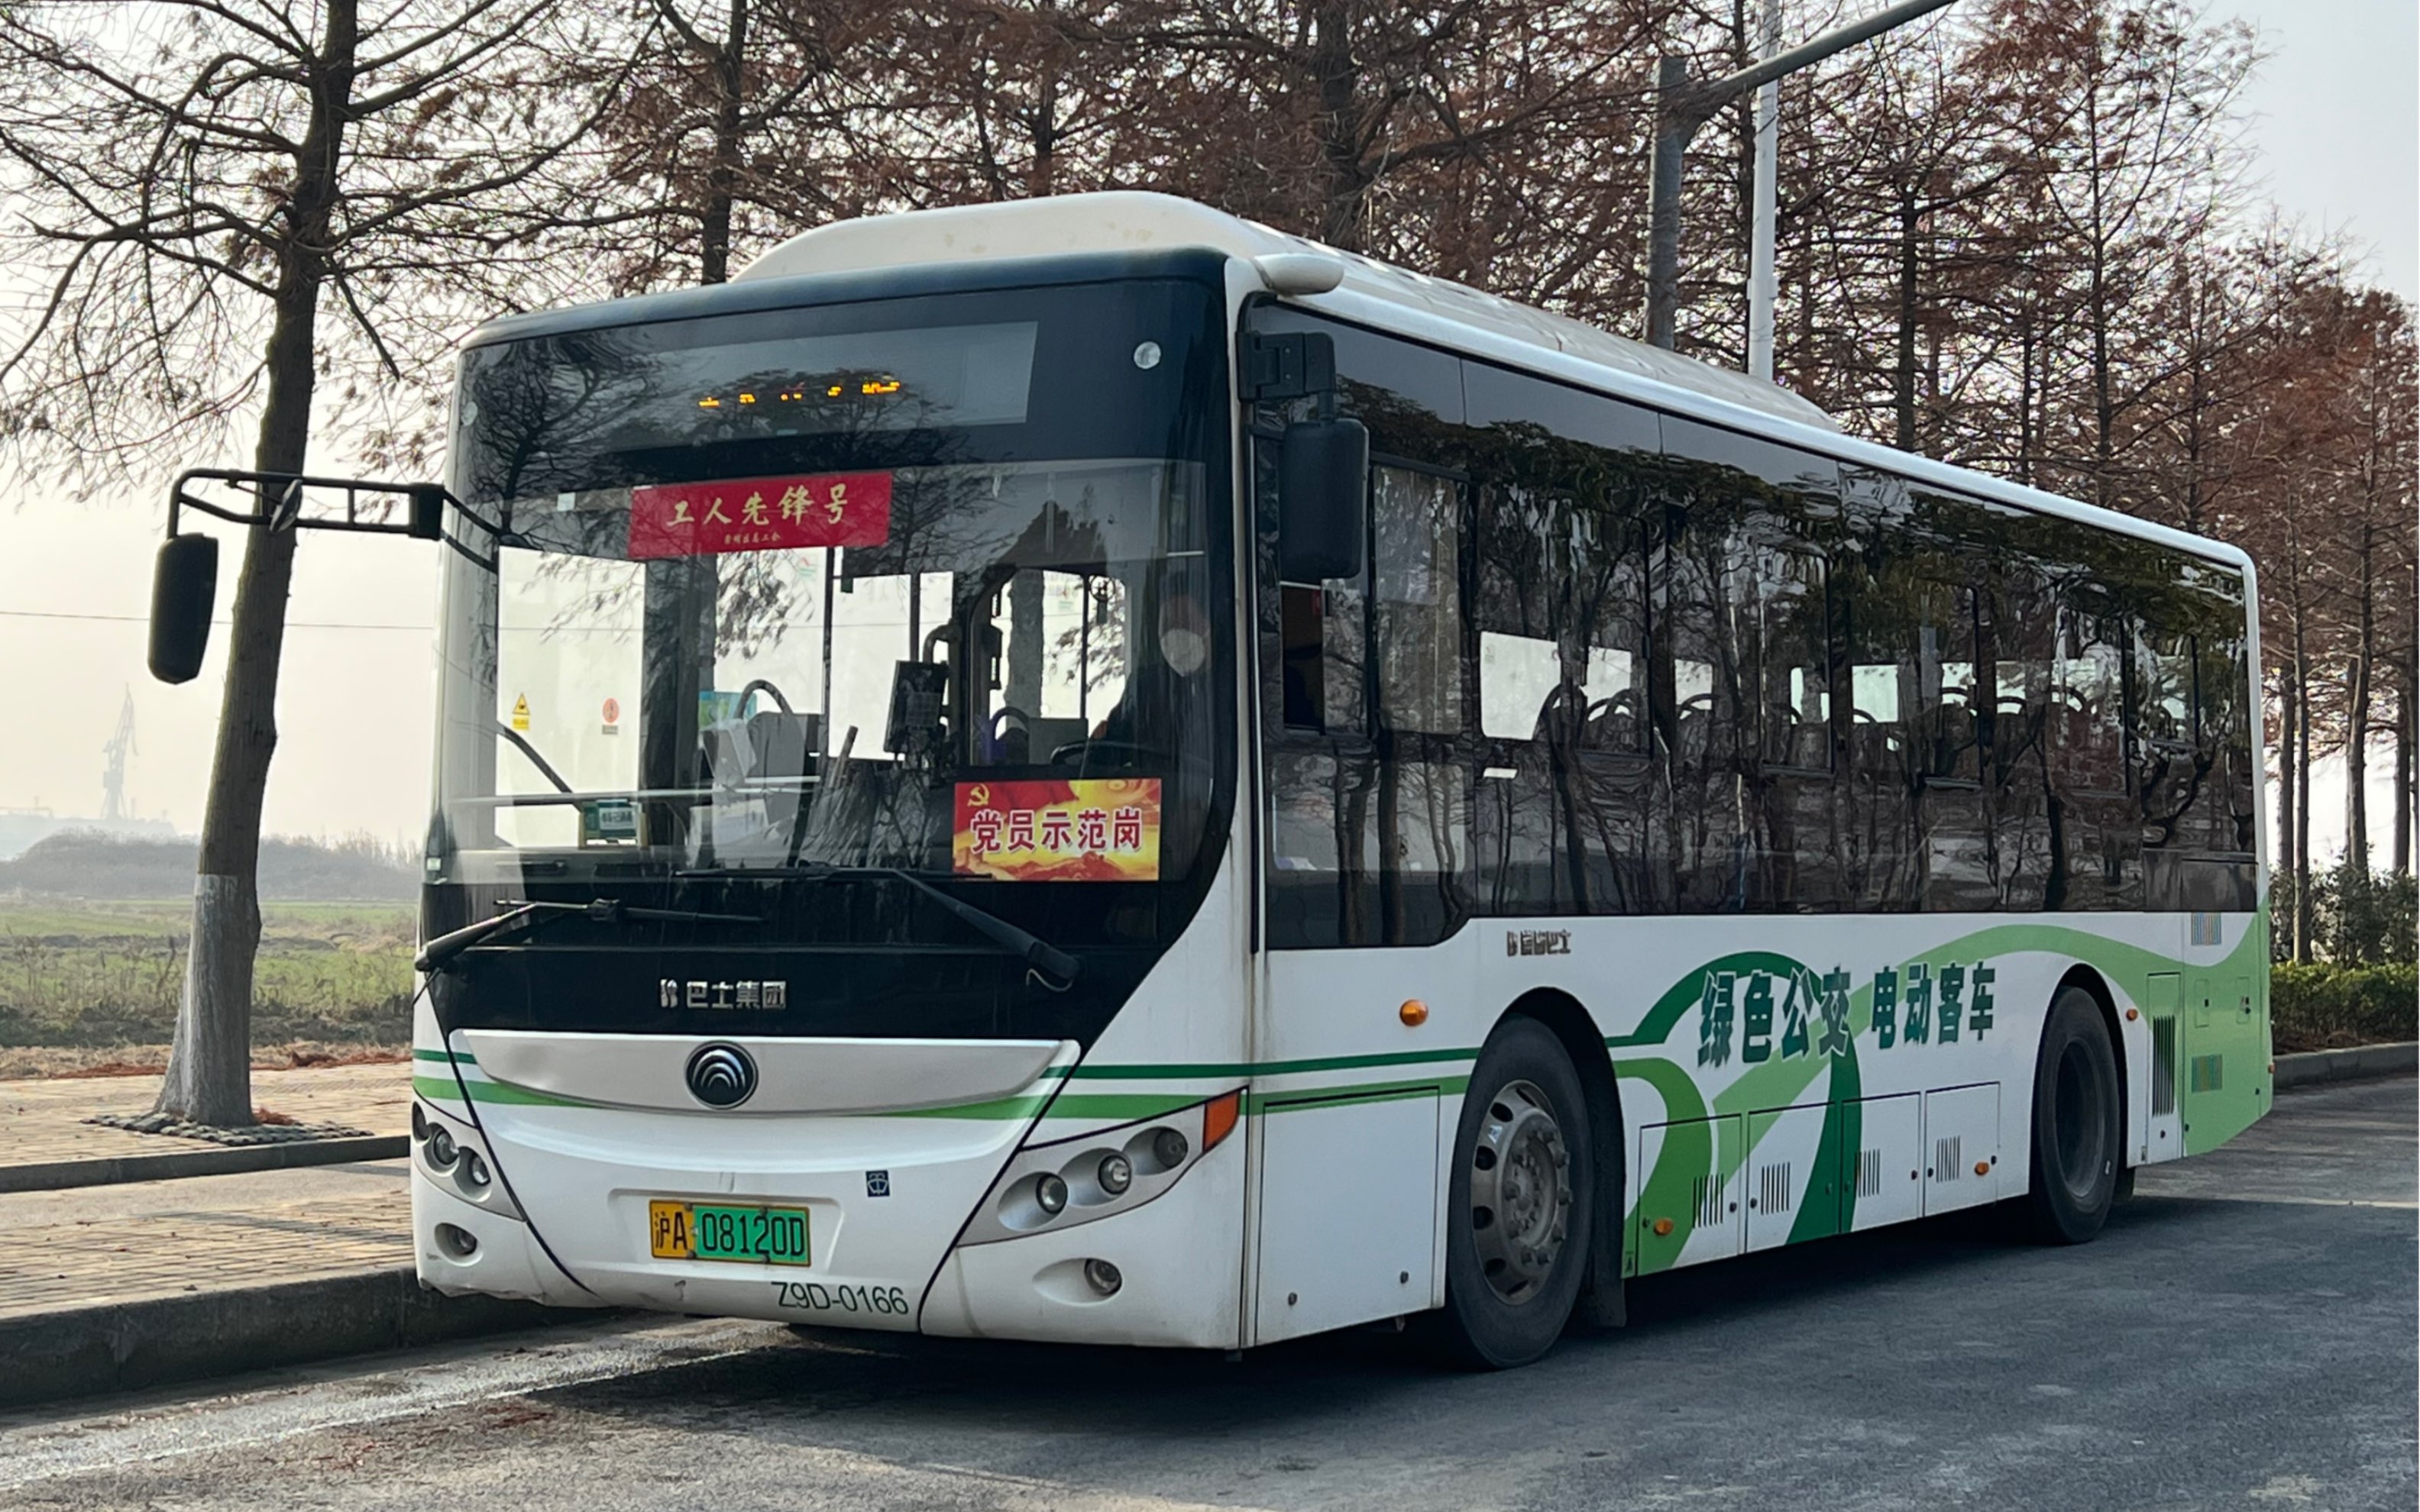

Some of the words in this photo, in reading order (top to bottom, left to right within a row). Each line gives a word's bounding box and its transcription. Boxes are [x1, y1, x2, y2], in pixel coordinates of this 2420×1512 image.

[666, 483, 848, 525] 工人先锋号
[971, 806, 1142, 853] 党员示范岗
[687, 980, 787, 1009] 巴士集团
[1697, 964, 1851, 1068] 绿色公交
[1872, 961, 1995, 1049] 电动客车
[771, 1281, 908, 1315] Z9D-0166
